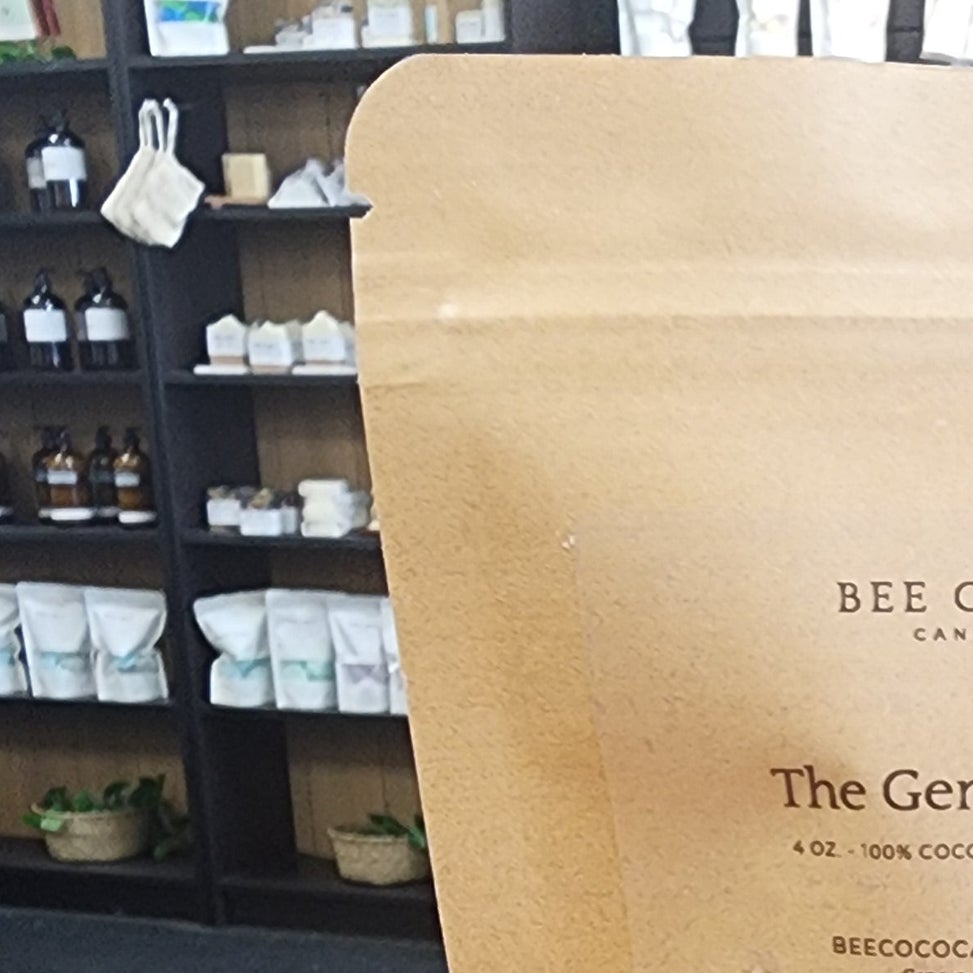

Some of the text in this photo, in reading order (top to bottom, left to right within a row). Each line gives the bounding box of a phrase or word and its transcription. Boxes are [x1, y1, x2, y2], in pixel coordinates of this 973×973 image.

[838, 581, 928, 614] BEE
[770, 765, 867, 811] The
[792, 840, 805, 855] 4
[861, 844, 912, 860] 100%
